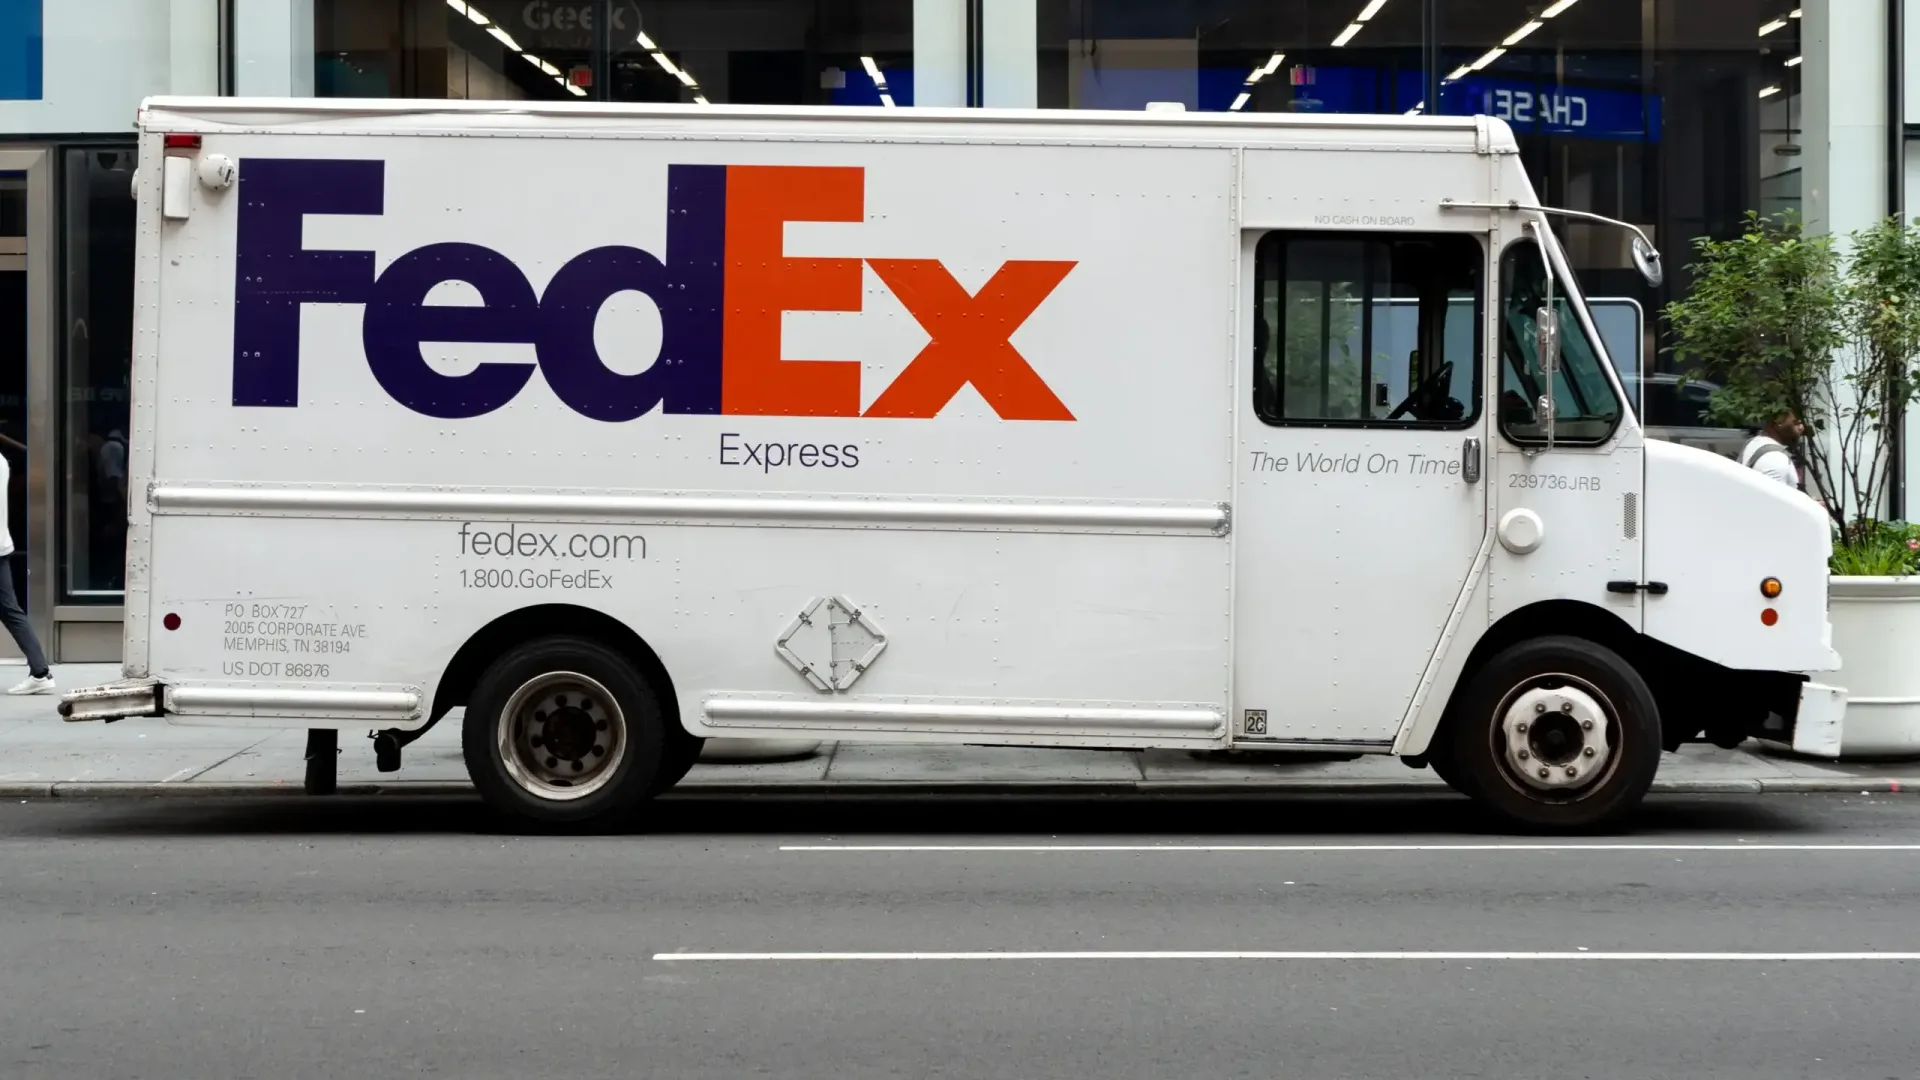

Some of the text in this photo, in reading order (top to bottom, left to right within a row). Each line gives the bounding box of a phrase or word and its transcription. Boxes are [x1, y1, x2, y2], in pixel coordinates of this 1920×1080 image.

[1314, 215, 1415, 226] NO CASH ON BOARD
[232, 158, 1078, 422] FedEx
[720, 433, 859, 474] Express
[1250, 451, 1460, 475] The World On Time
[1508, 473, 1601, 491] 239736JRB
[458, 522, 647, 559] fedex.com
[460, 568, 613, 589] 1.800.GoFedEx
[225, 604, 305, 619] PO BOX 727
[224, 620, 254, 634] 2005
[258, 621, 338, 637] CORPORATE
[224, 637, 350, 653] MEMPHIS, TN 38194
[223, 661, 330, 677] US DOT 86876
